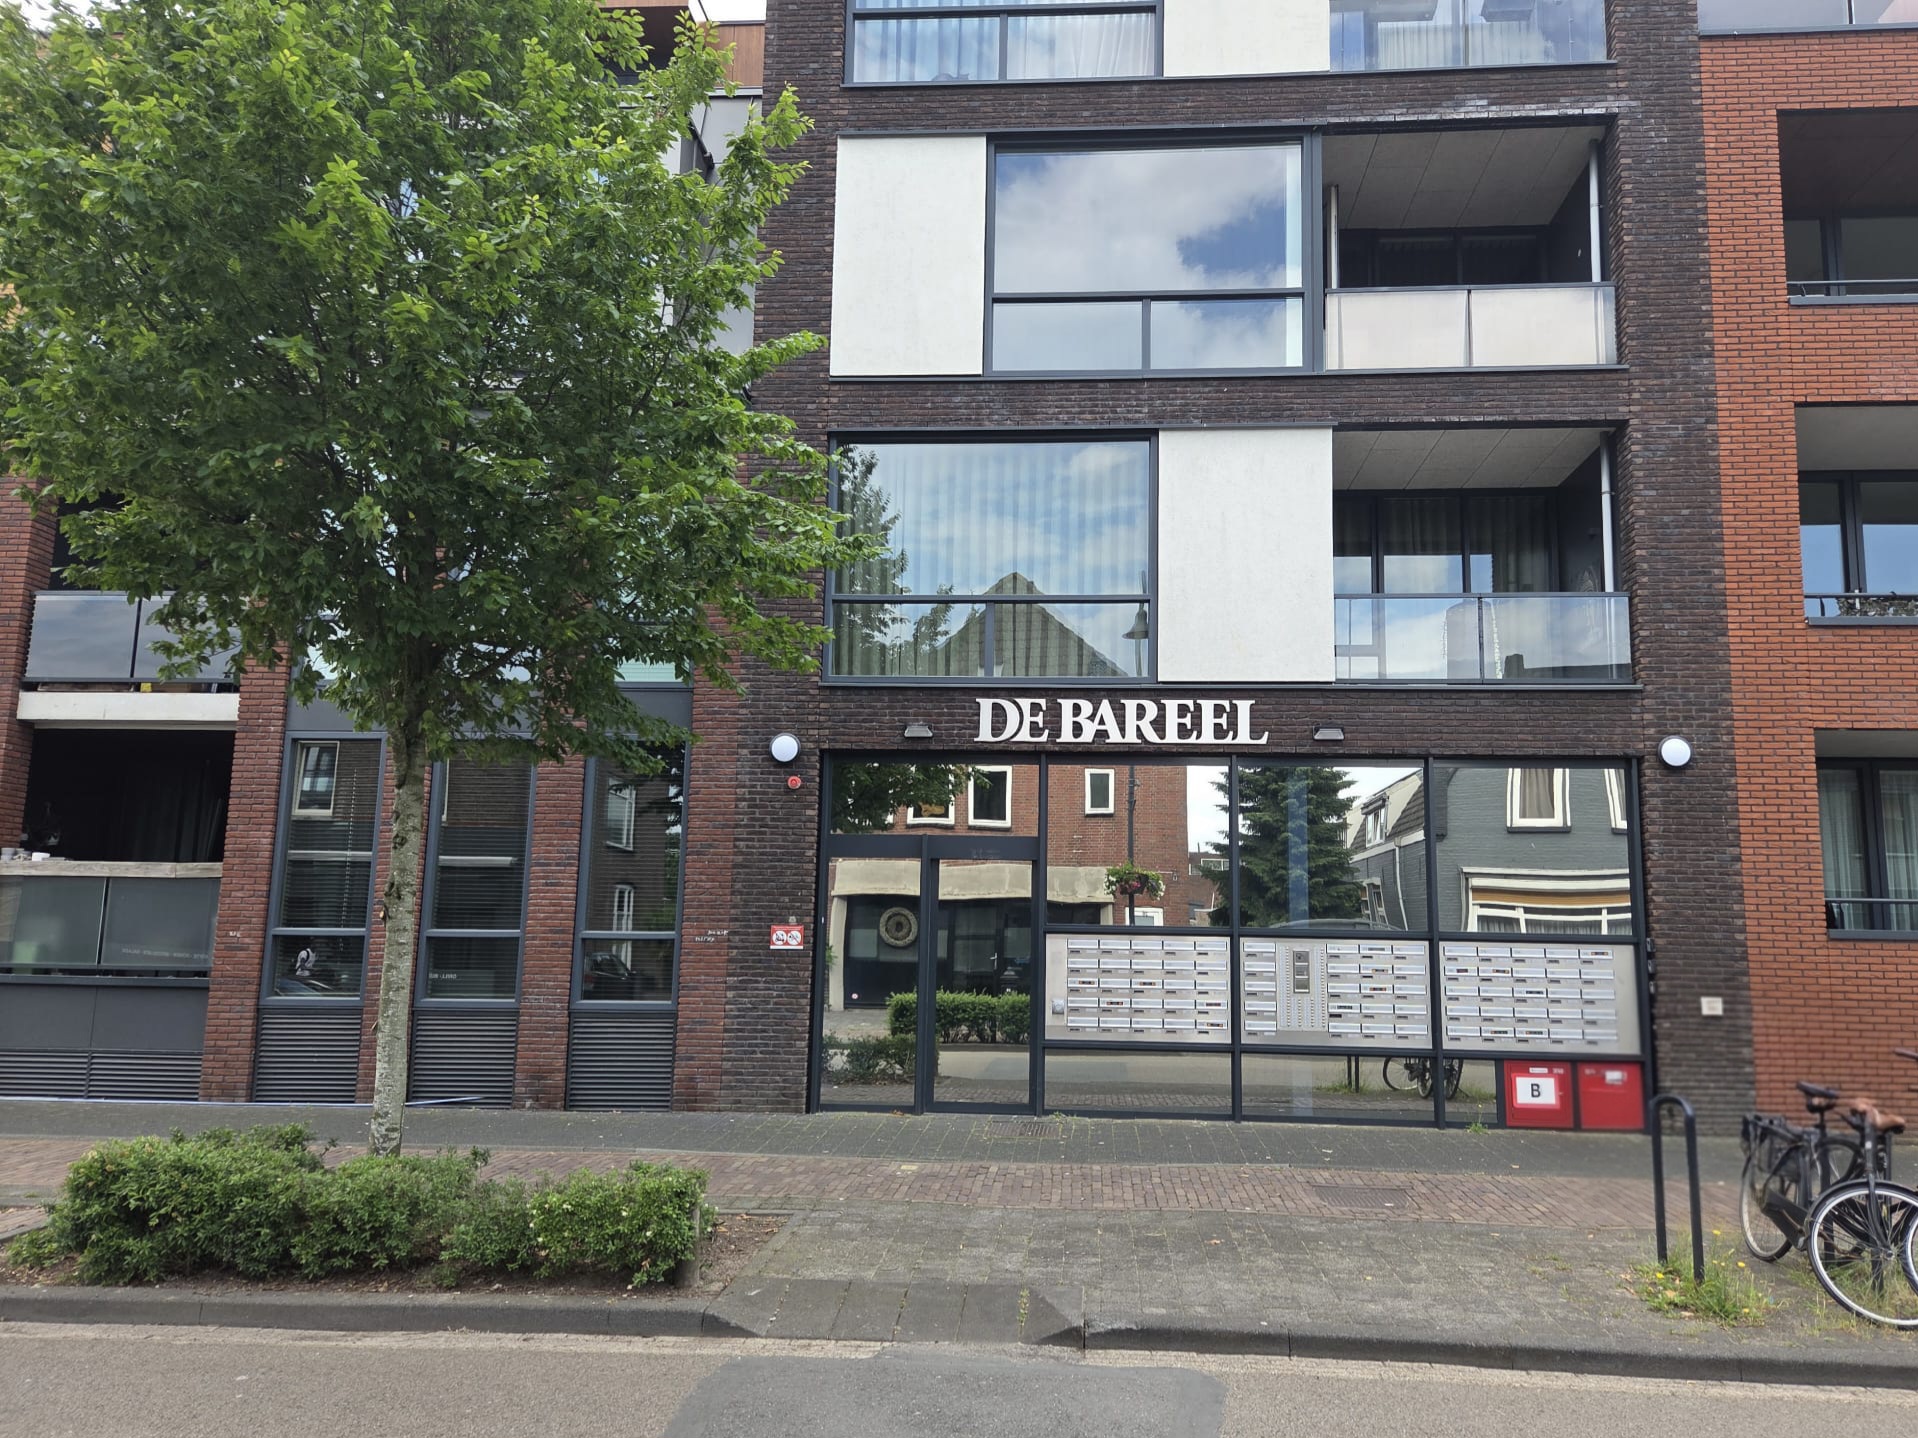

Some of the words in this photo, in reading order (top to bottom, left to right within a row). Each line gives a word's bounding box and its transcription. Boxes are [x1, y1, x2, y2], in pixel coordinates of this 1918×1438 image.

[974, 698, 1049, 742] DE
[1056, 698, 1269, 744] BAREEL
[1530, 1083, 1541, 1098] B
